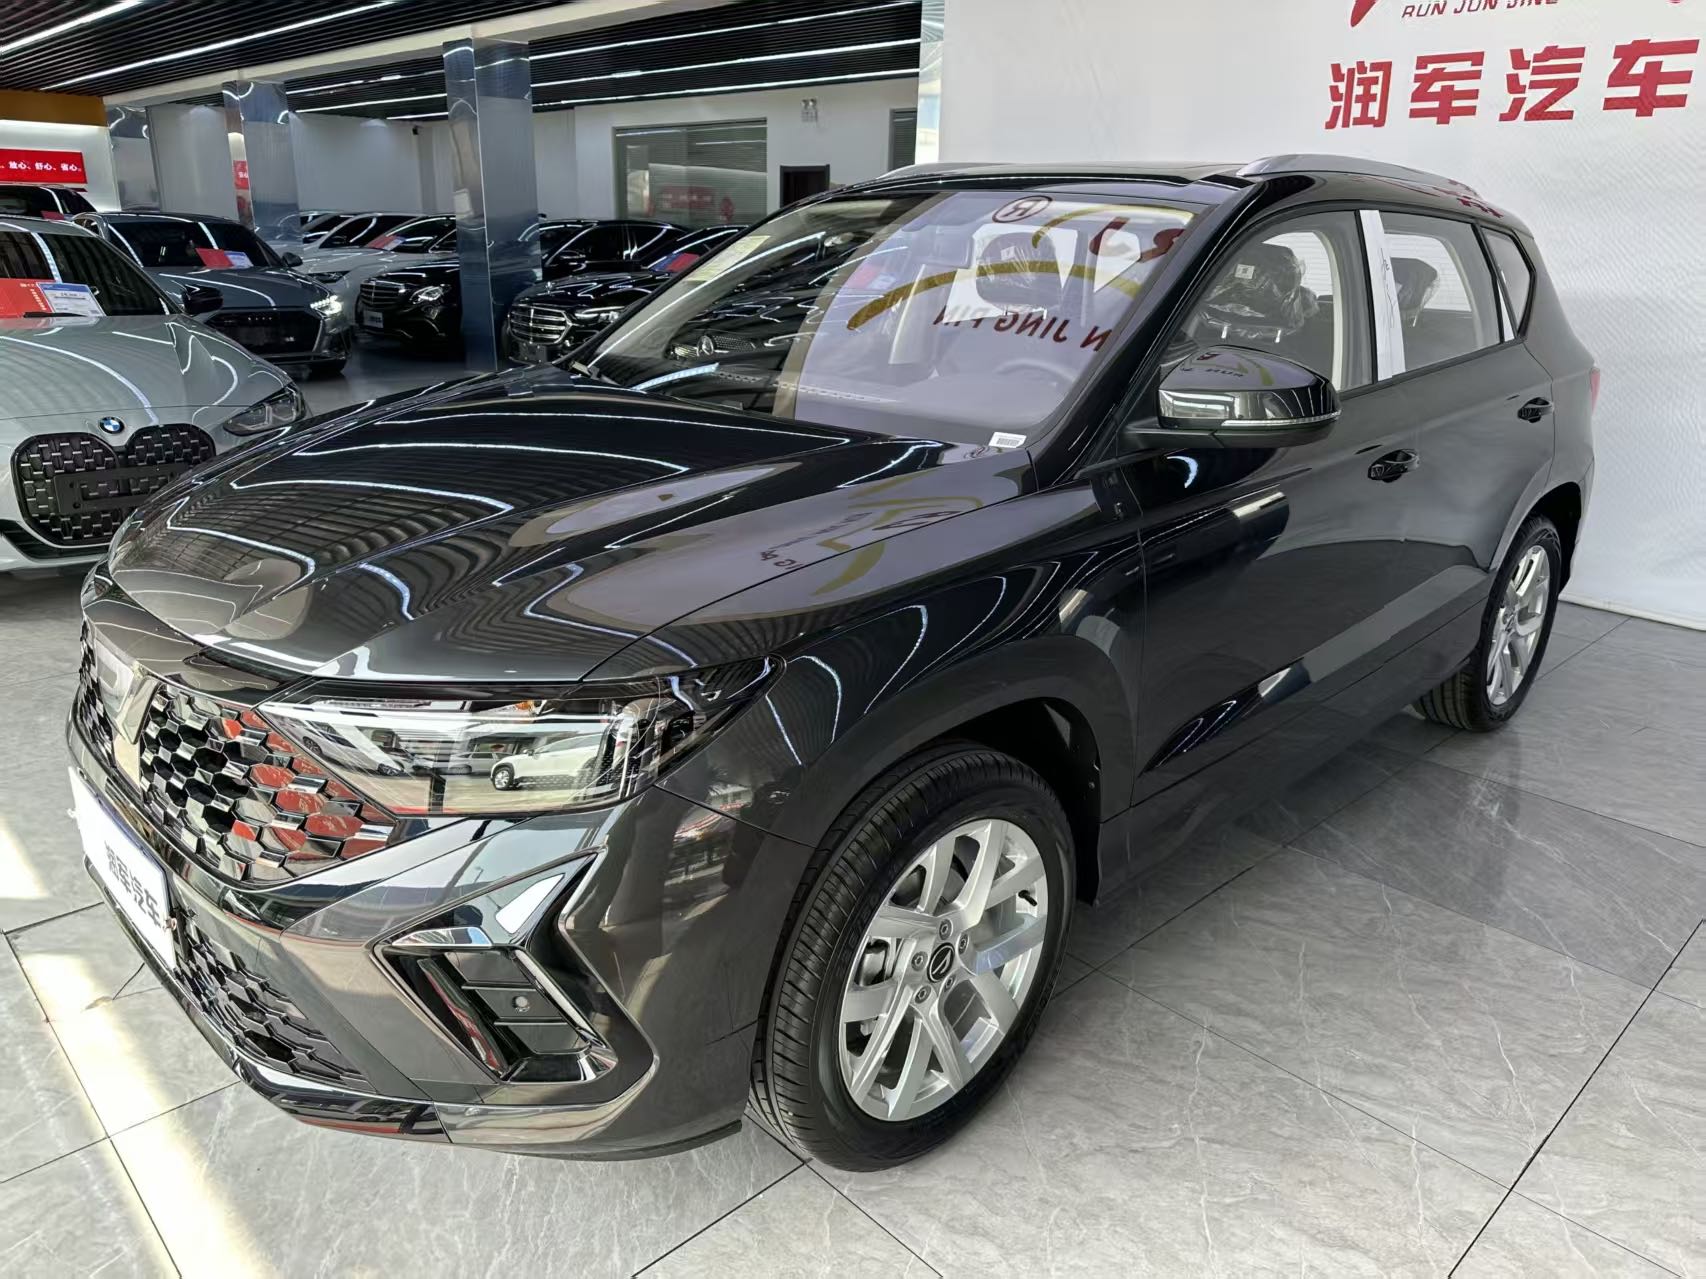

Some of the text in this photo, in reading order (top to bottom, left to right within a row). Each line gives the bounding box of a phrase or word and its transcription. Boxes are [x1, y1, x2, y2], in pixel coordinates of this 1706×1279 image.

[1401, 1, 1447, 18] RUN
[1325, 39, 1700, 130] 润军汽车
